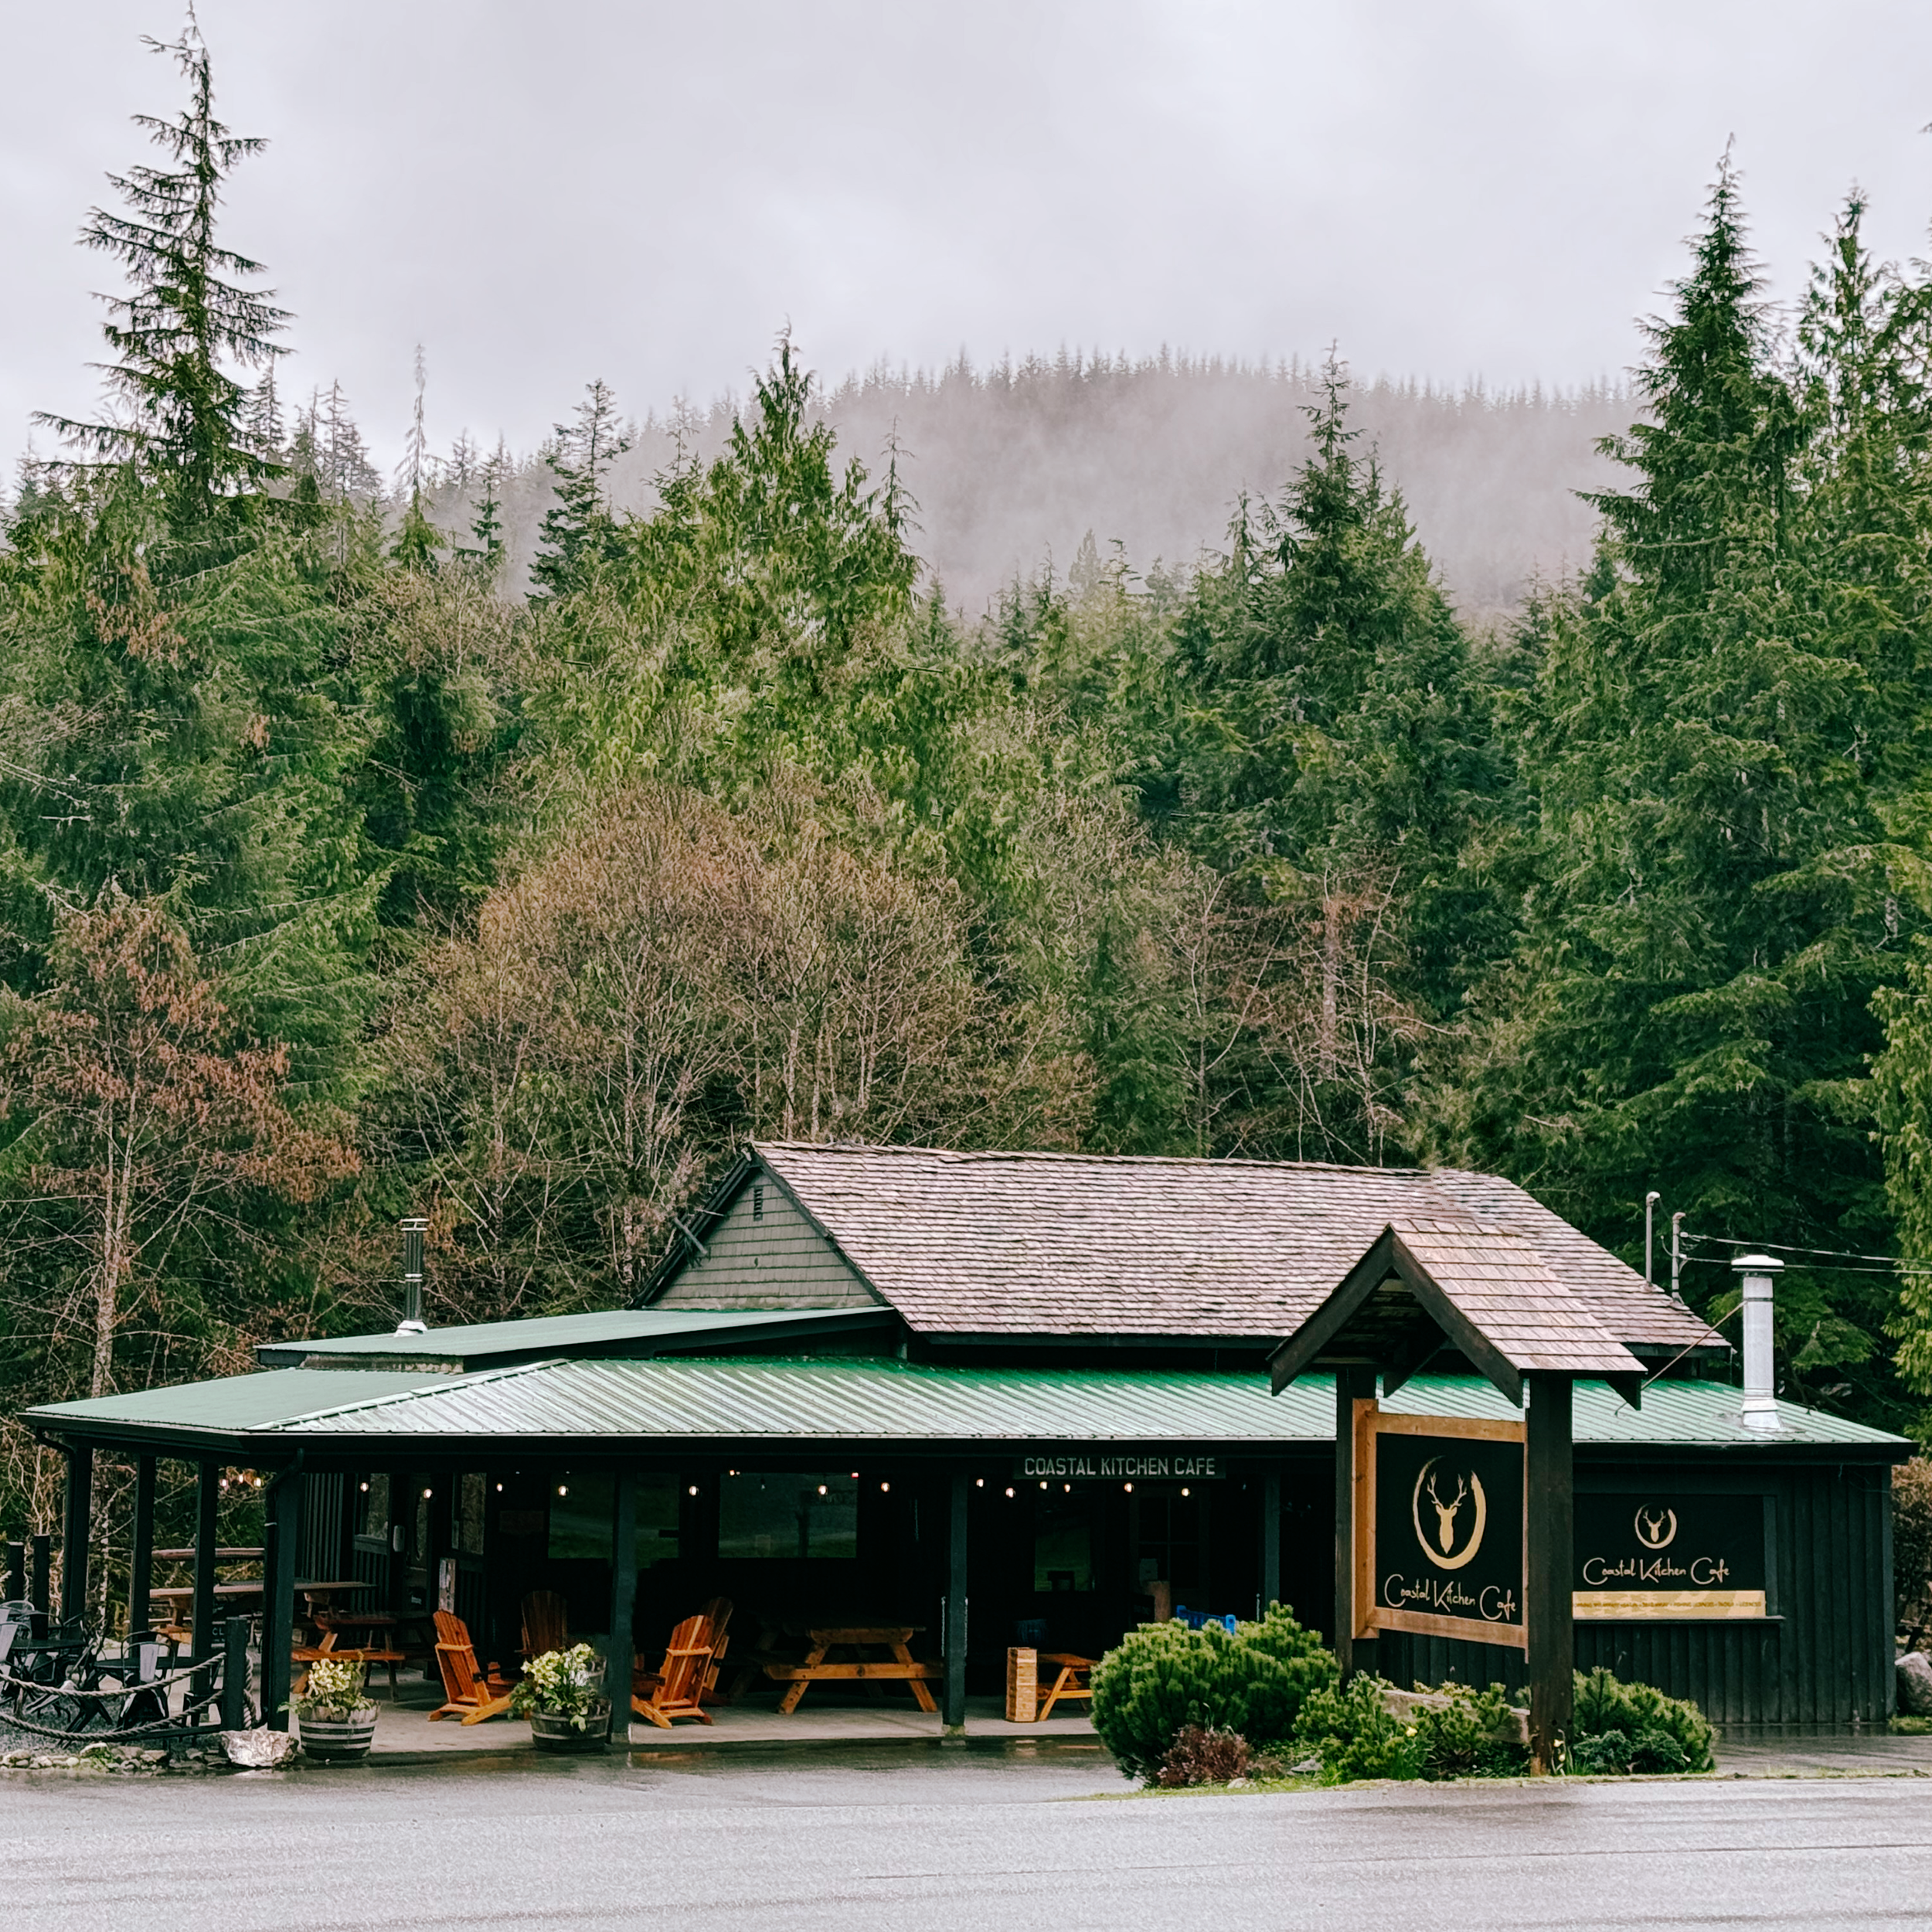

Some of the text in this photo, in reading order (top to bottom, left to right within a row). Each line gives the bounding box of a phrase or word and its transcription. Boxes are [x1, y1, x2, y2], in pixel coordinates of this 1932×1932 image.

[1024, 1458, 1216, 1476] COASTAL KITCHEN CAFE
[1583, 1556, 1730, 1585] Coastal Kitchen Cafe
[1383, 1573, 1518, 1621] Coastal Kitchen Cafe
